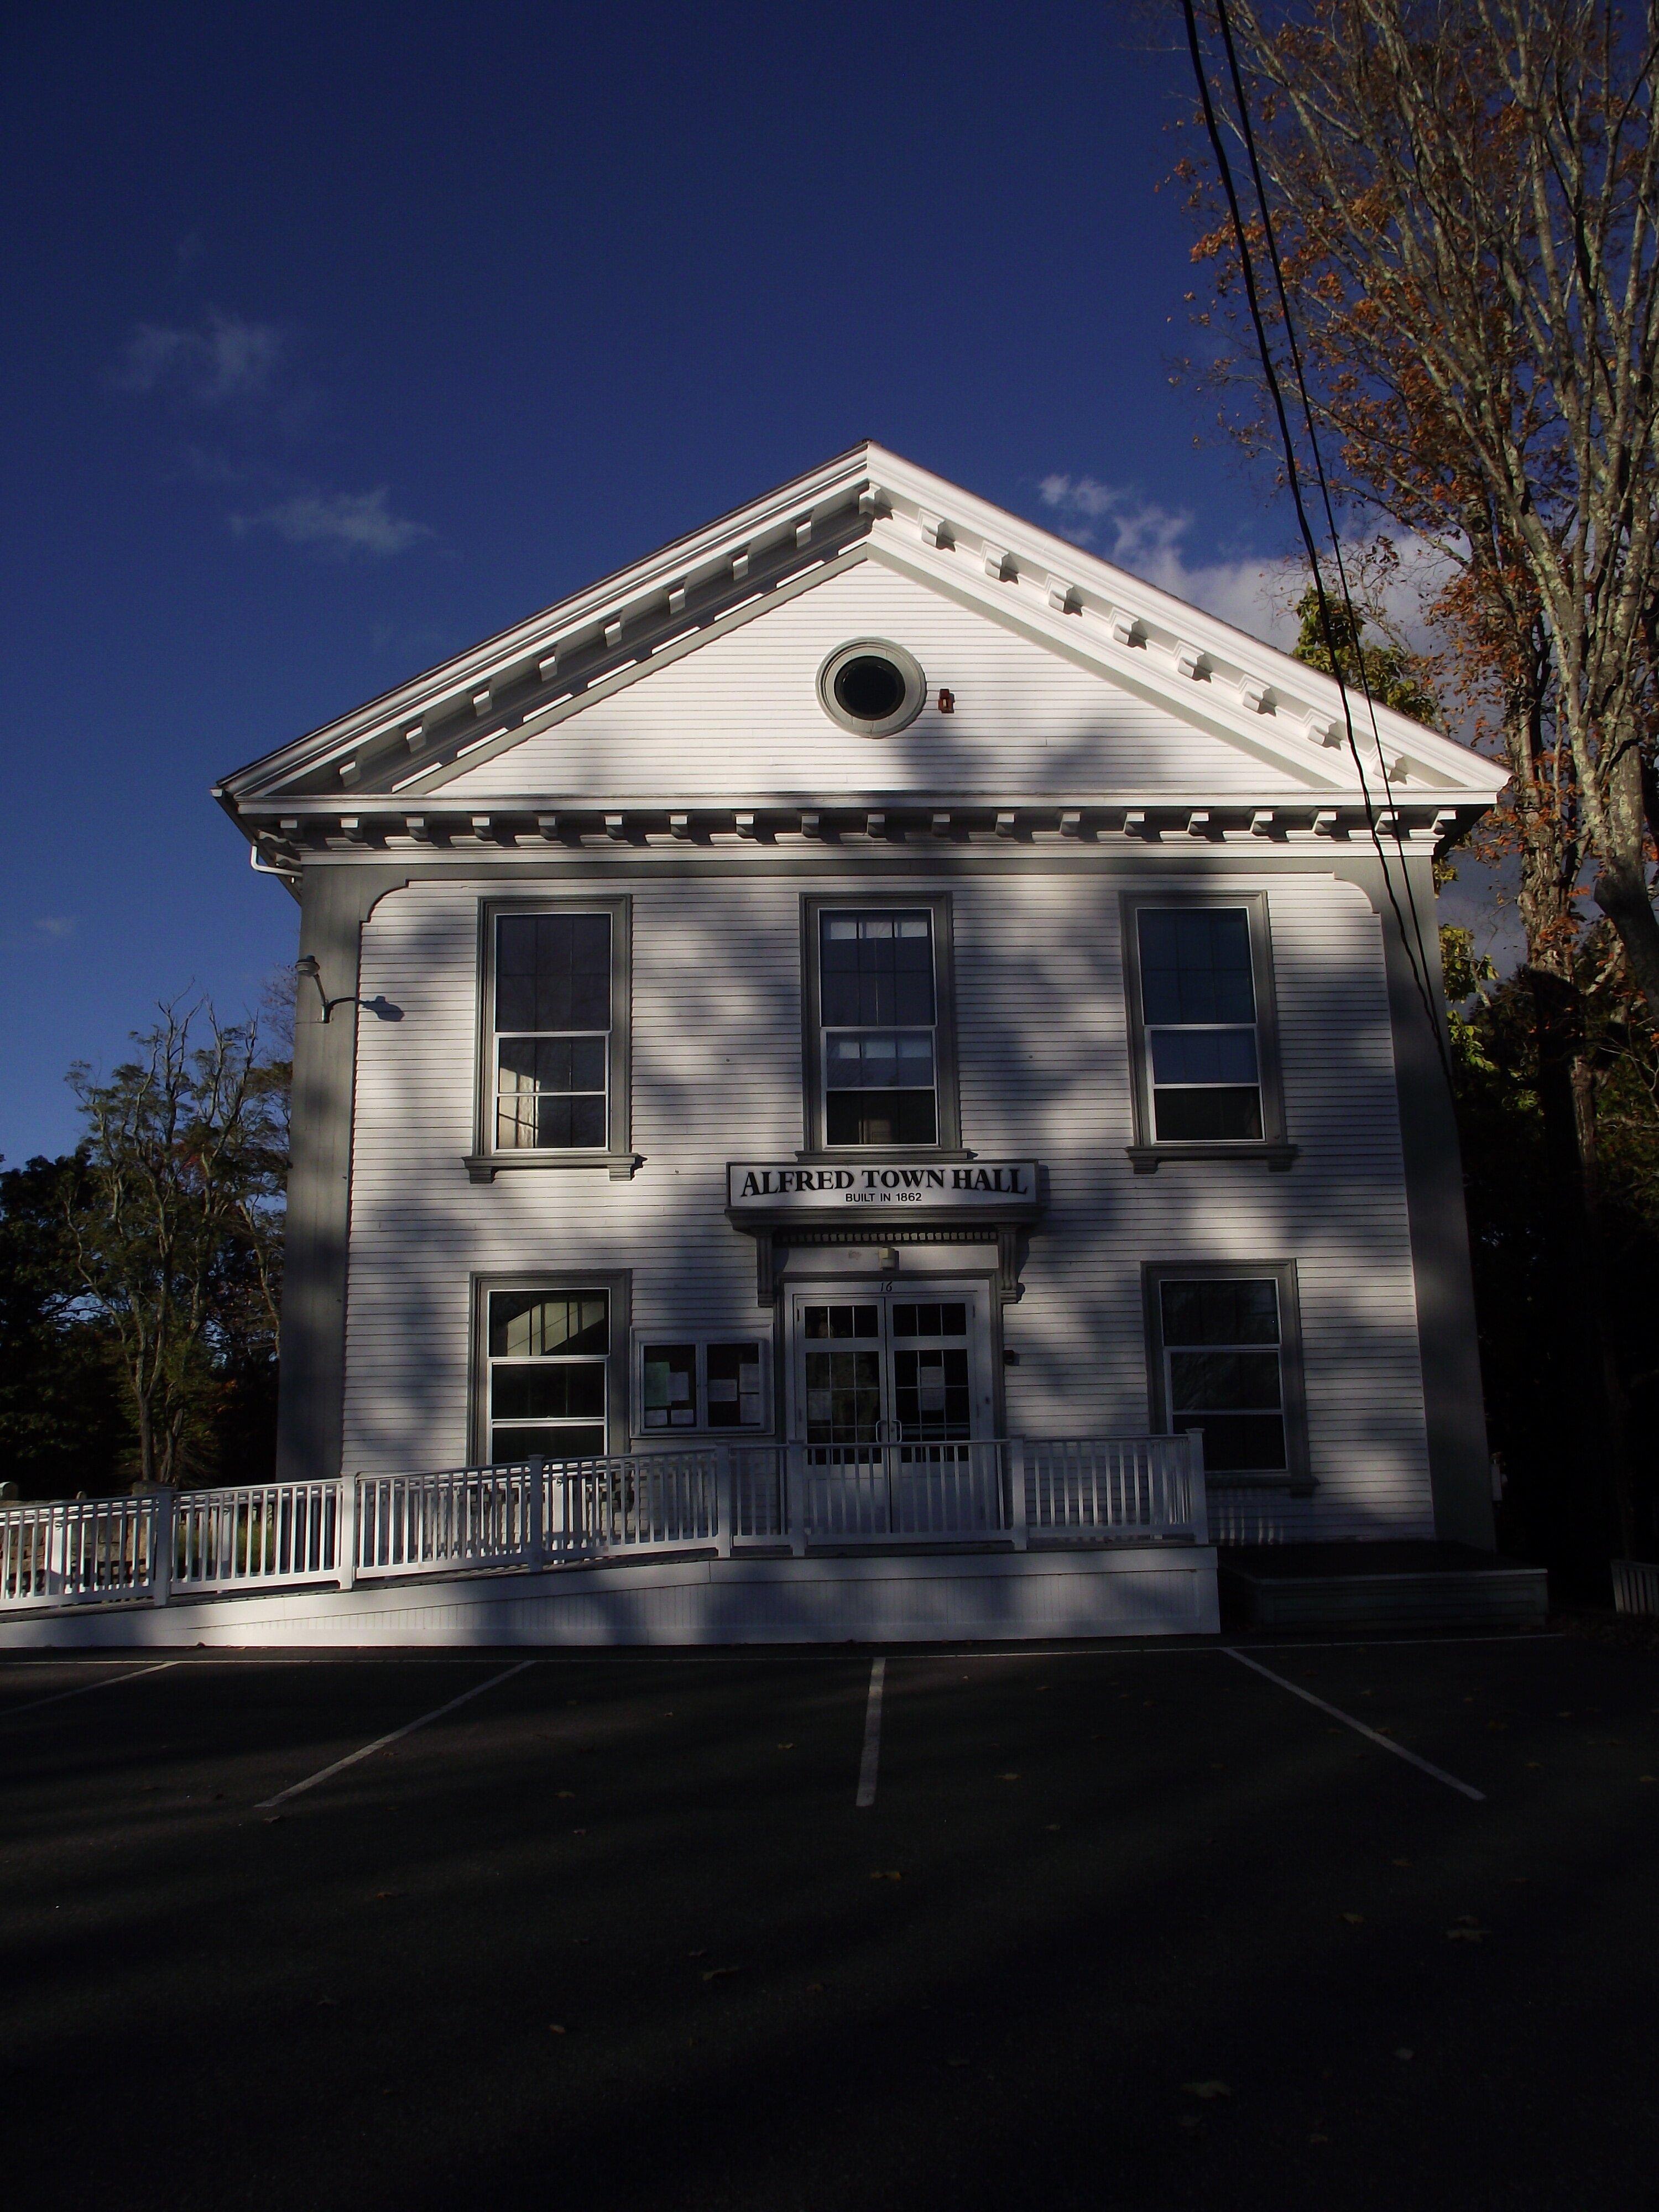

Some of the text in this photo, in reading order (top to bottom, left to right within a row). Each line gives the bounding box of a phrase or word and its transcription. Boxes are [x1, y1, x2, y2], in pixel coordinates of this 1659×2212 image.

[740, 1167, 1029, 1198] ALFRED TOWN HALL
[845, 1192, 922, 1202] BUILT IN 1862
[880, 1281, 893, 1292] 16
